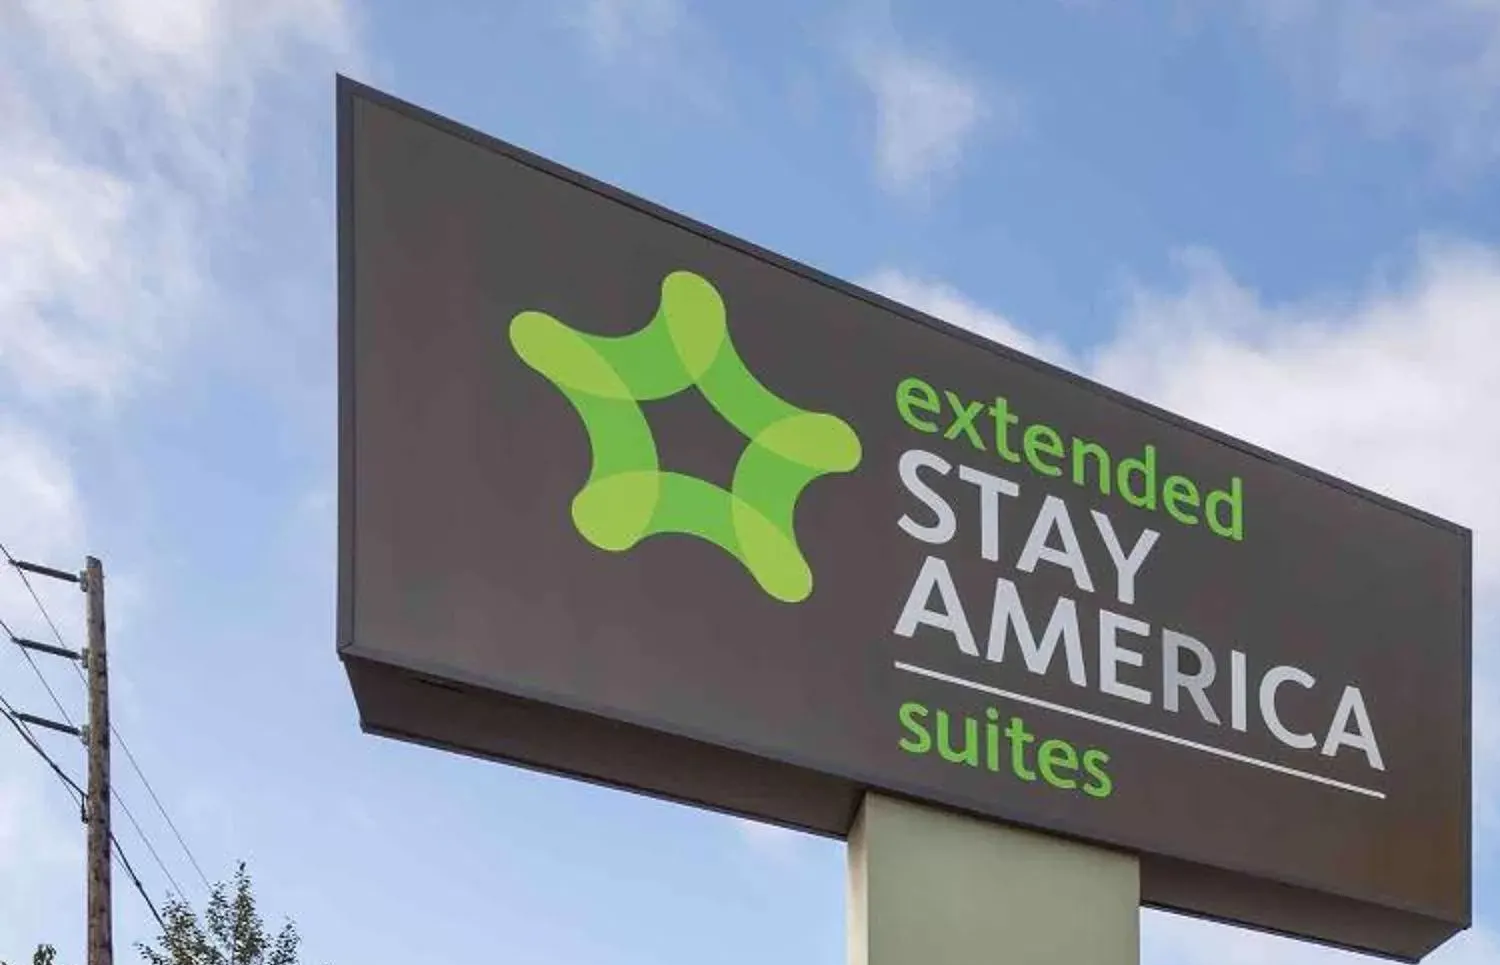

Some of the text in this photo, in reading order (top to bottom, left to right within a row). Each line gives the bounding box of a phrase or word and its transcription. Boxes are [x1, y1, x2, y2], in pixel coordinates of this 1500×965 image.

[896, 377, 1244, 540] extended
[897, 449, 1160, 604] STAY
[894, 556, 1385, 771] AMERICA
[898, 702, 1113, 798] suites
